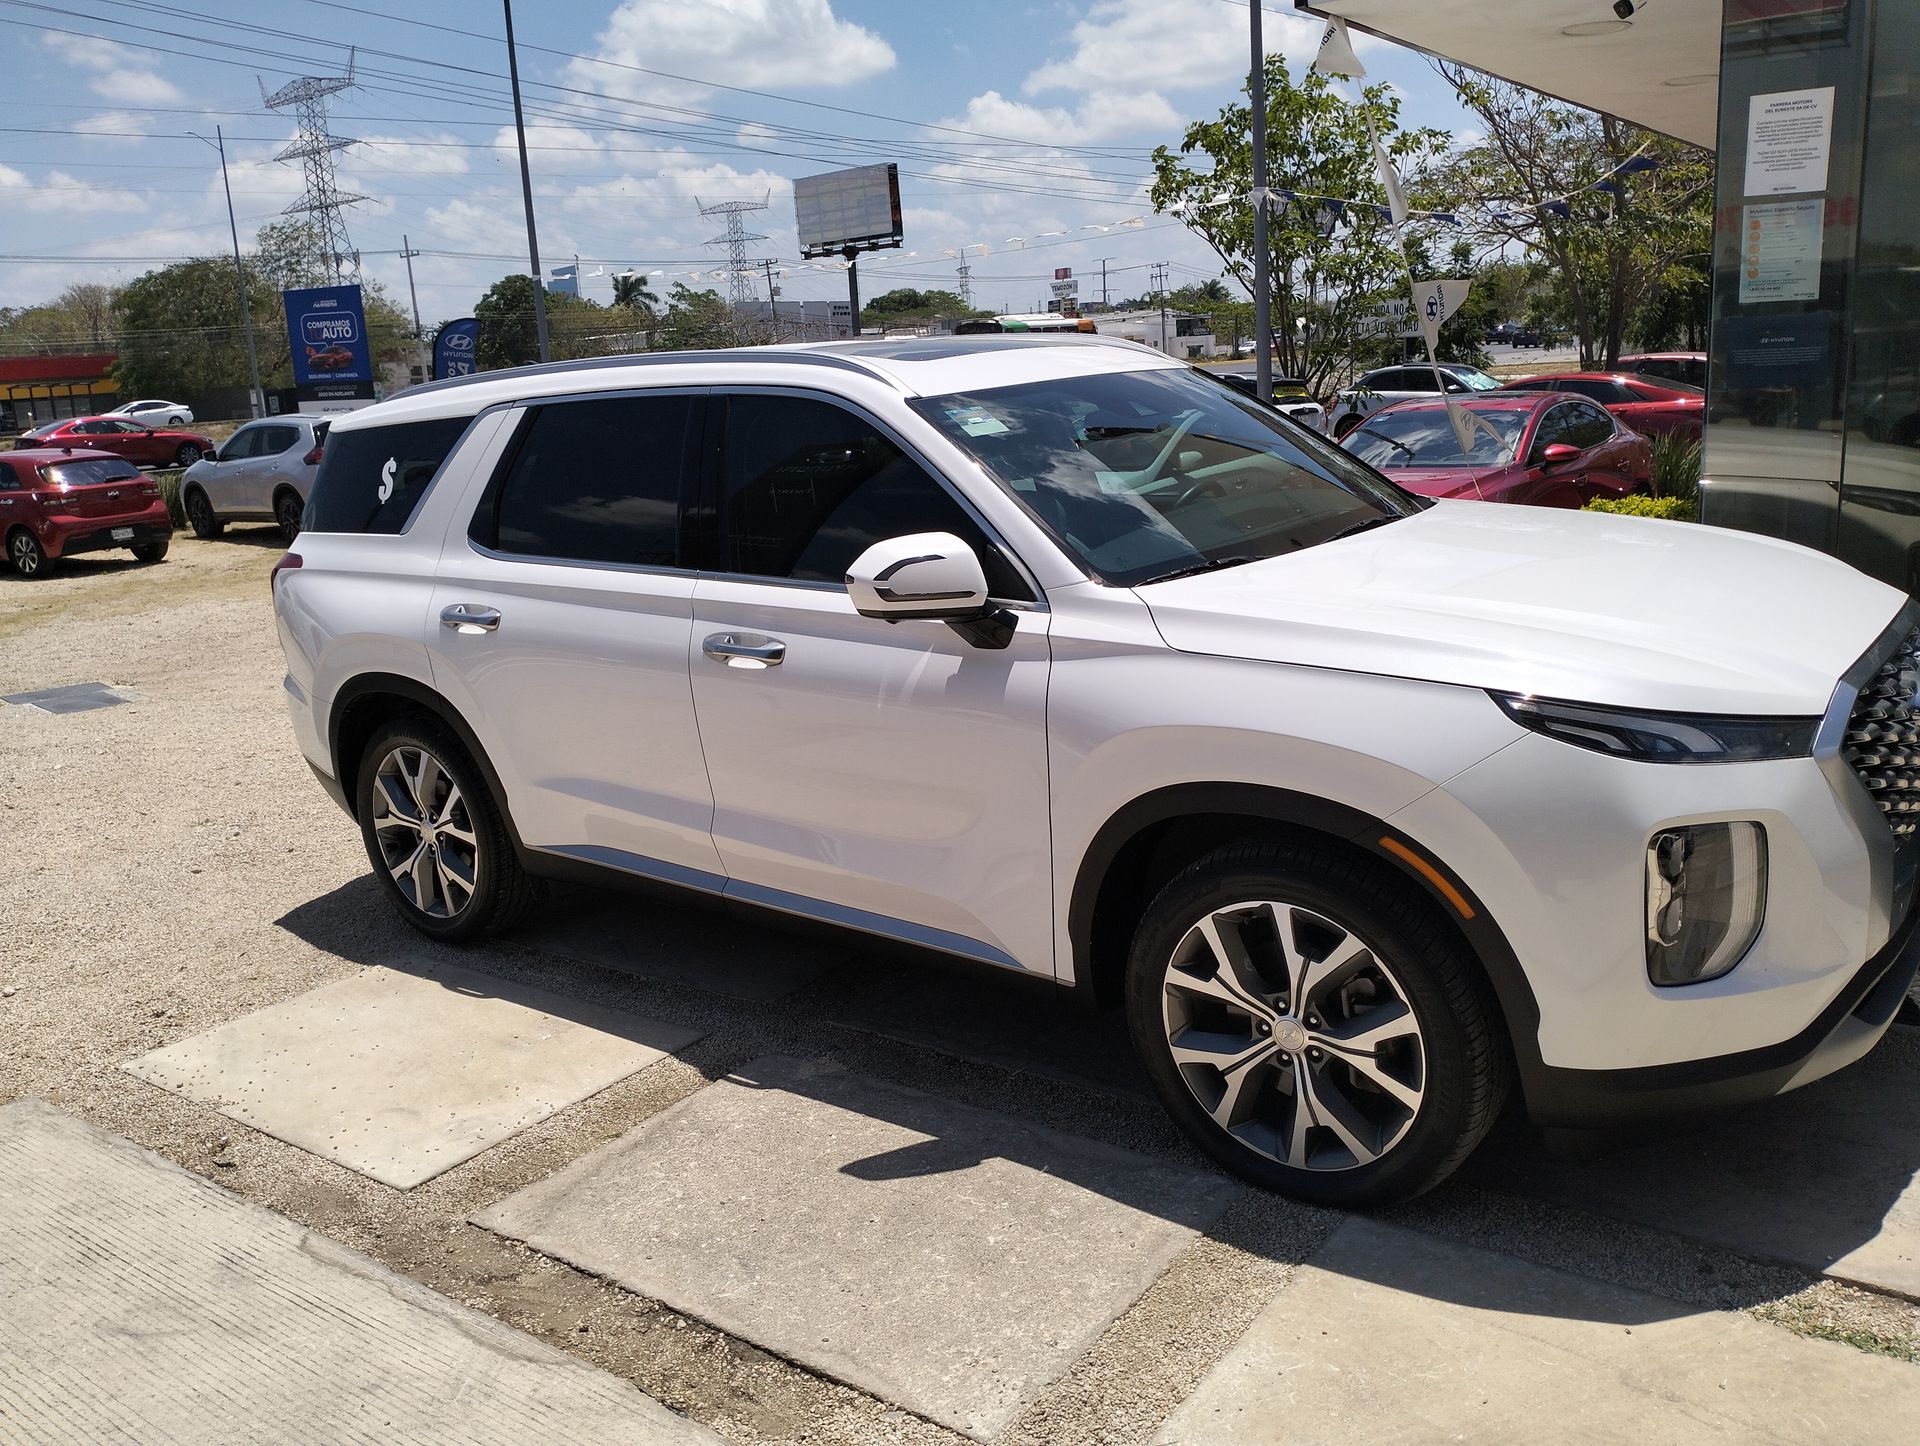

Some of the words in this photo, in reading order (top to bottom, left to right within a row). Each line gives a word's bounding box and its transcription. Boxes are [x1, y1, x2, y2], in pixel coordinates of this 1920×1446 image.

[1436, 283, 1445, 322] HYUNDAI
[1393, 303, 1404, 316] NO
[307, 320, 351, 329] COMPRAMOS
[322, 327, 352, 339] AUTO
